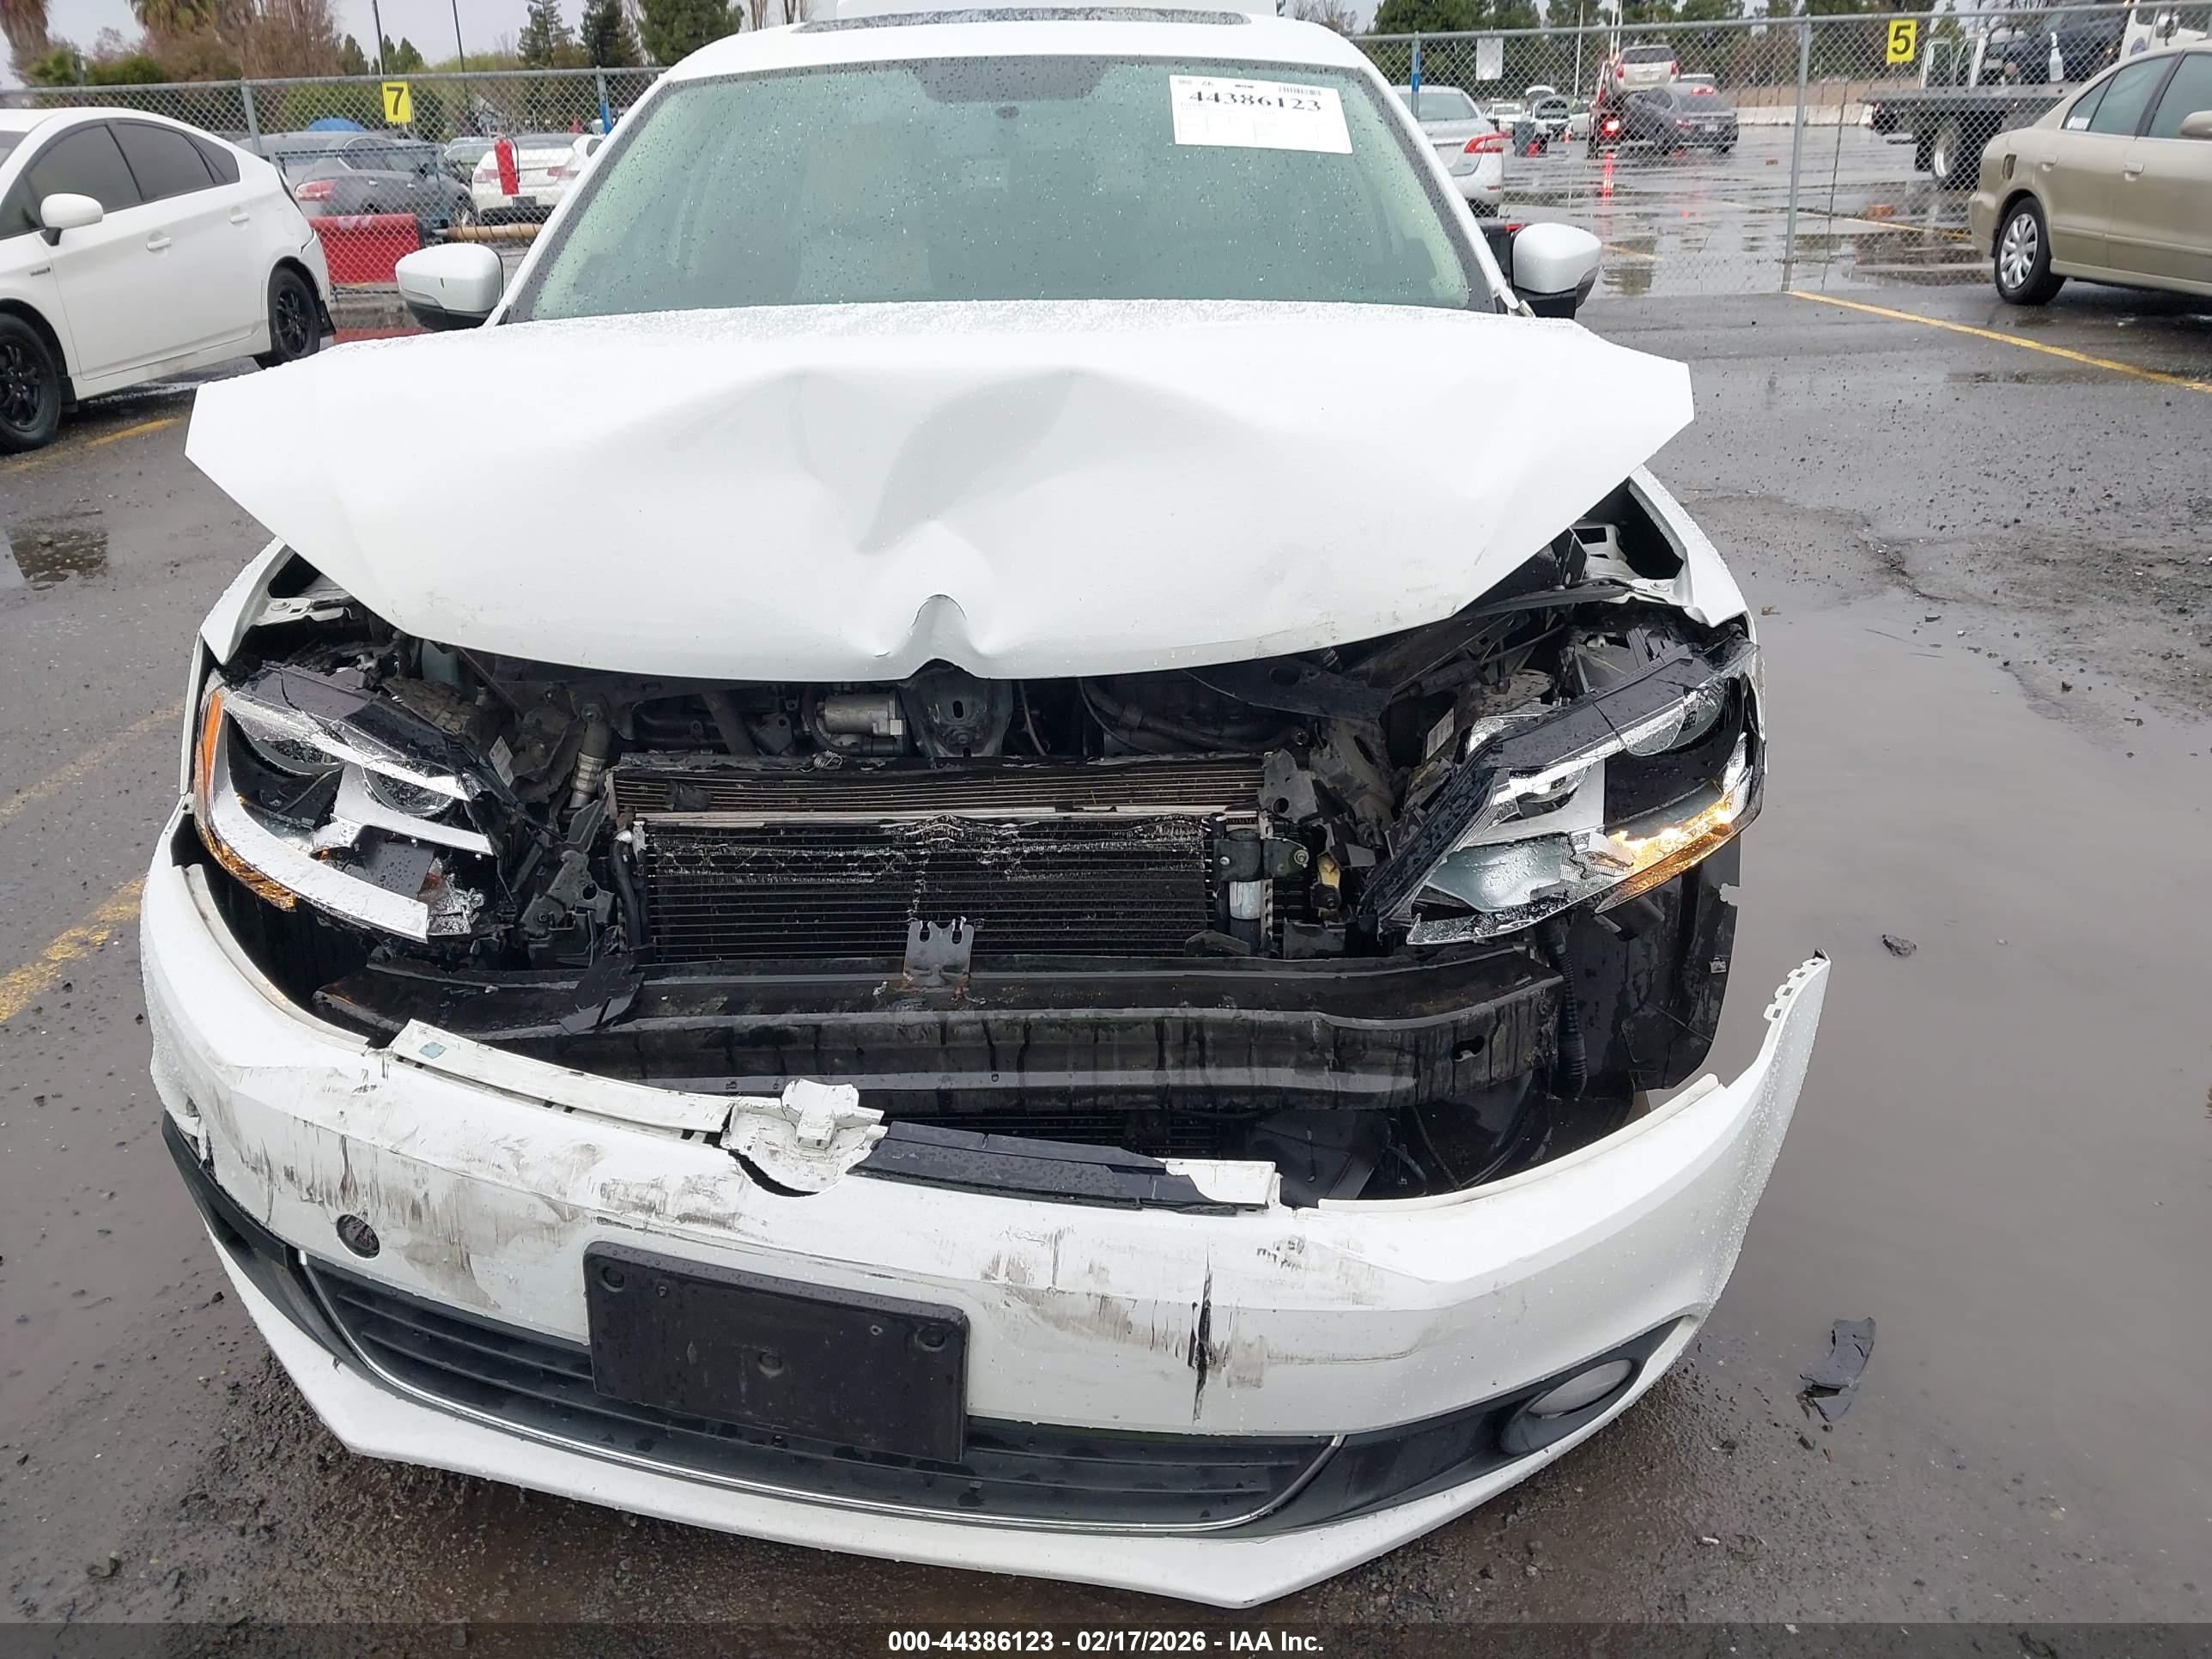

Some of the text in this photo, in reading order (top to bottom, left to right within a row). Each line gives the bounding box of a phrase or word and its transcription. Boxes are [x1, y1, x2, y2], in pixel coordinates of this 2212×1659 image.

[1892, 25, 1911, 55] 5
[386, 86, 404, 116] 7
[1189, 91, 1322, 112] 44386123
